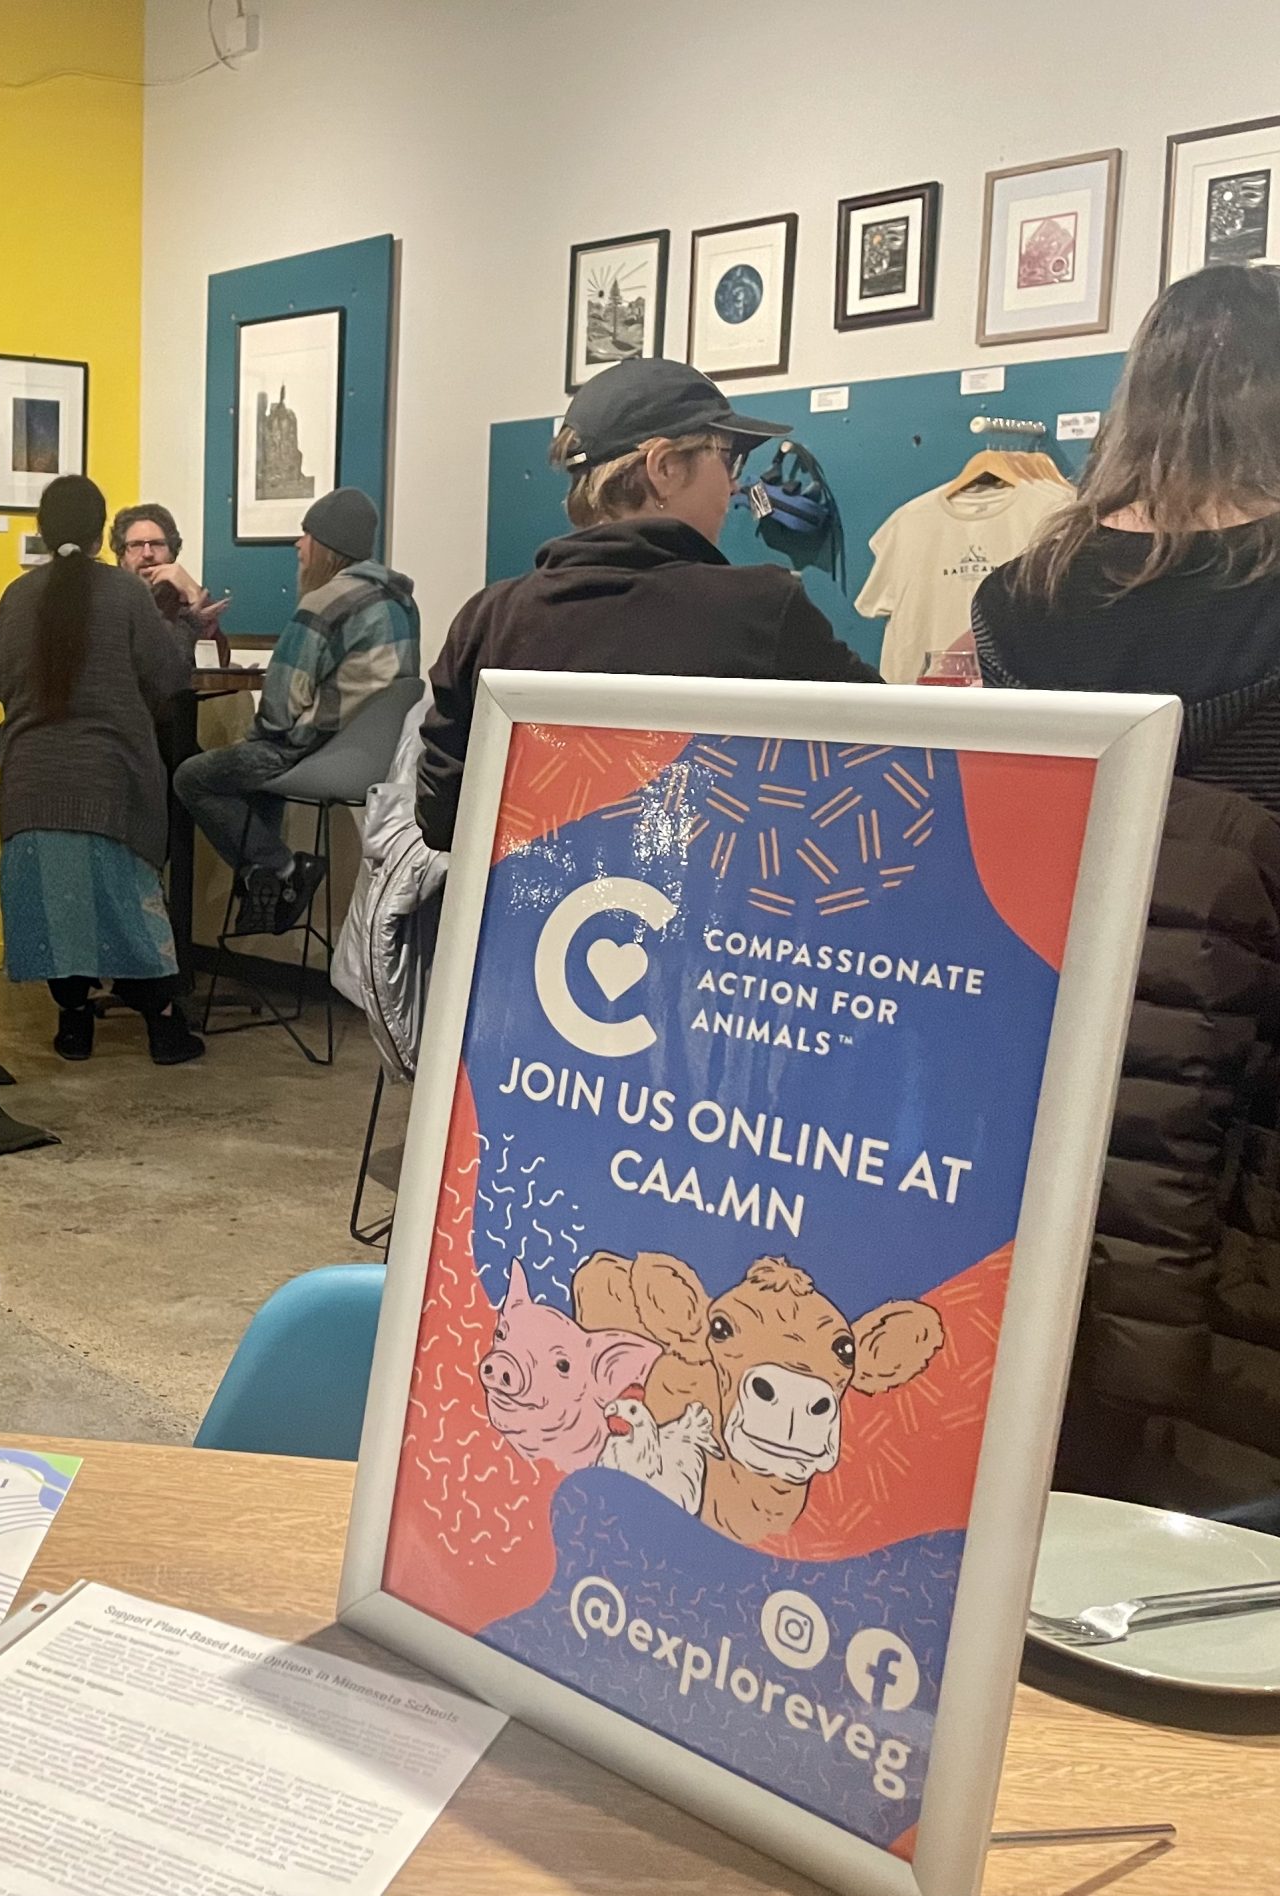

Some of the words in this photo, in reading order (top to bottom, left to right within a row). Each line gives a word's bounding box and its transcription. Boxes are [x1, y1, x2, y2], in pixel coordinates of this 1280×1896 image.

[697, 968, 818, 1011] ACTION
[831, 990, 899, 1025] FOR
[704, 928, 985, 996] COMPASSIONATE
[499, 1056, 606, 1116] JOIN
[617, 1080, 676, 1133] US
[687, 1099, 890, 1186] ONLINE
[898, 1150, 973, 1204] AT
[609, 1149, 805, 1239] CAA.MN
[103, 1604, 153, 1627] Support
[152, 1618, 230, 1650] Plant-Based
[229, 1643, 263, 1662] Meal
[263, 1654, 314, 1677] Options
[316, 1669, 330, 1682] in
[332, 1673, 402, 1706] Minnesota
[404, 1698, 461, 1724] Schools
[570, 1576, 912, 1800] @exploreveg
